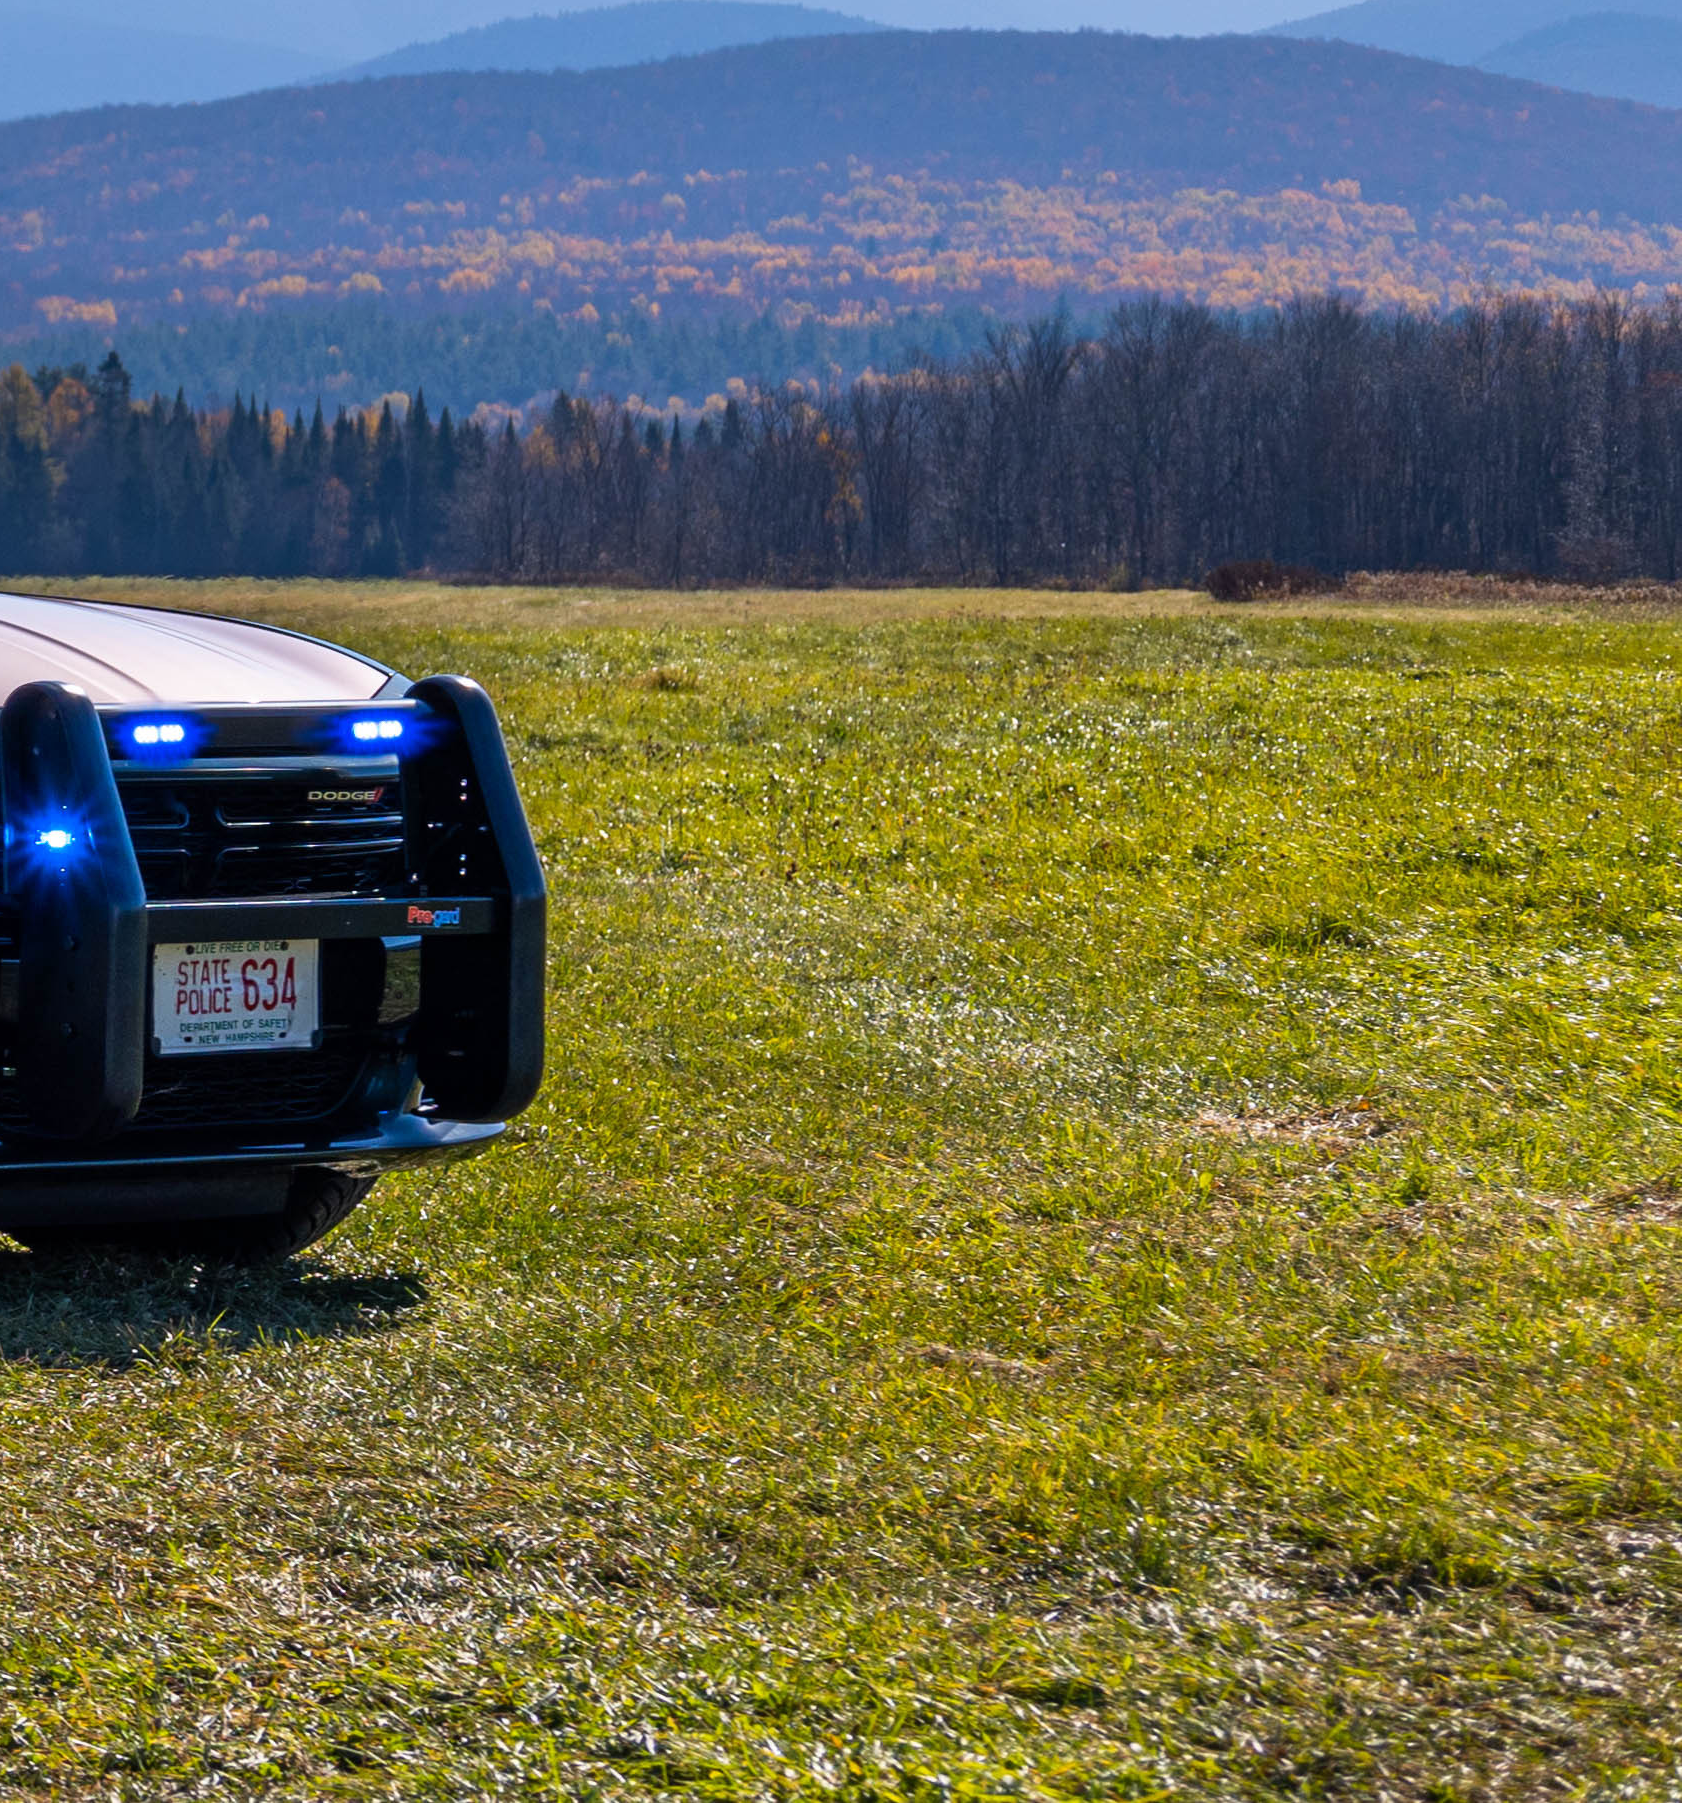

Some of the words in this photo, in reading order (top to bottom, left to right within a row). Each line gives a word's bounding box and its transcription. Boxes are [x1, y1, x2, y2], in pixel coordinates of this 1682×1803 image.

[307, 791, 377, 801] DODGE
[195, 944, 216, 955] LIVE
[220, 942, 244, 953] FREE
[246, 941, 260, 952] OR
[264, 940, 282, 951] DIE
[176, 958, 232, 986] STATE
[240, 956, 297, 1012] 634
[175, 986, 233, 1015] POLICE
[179, 1020, 239, 1033] DEPARTMENT
[242, 1019, 254, 1029] OF
[198, 1034, 220, 1044] NEW
[225, 1031, 276, 1042] HAMPSHIRE
